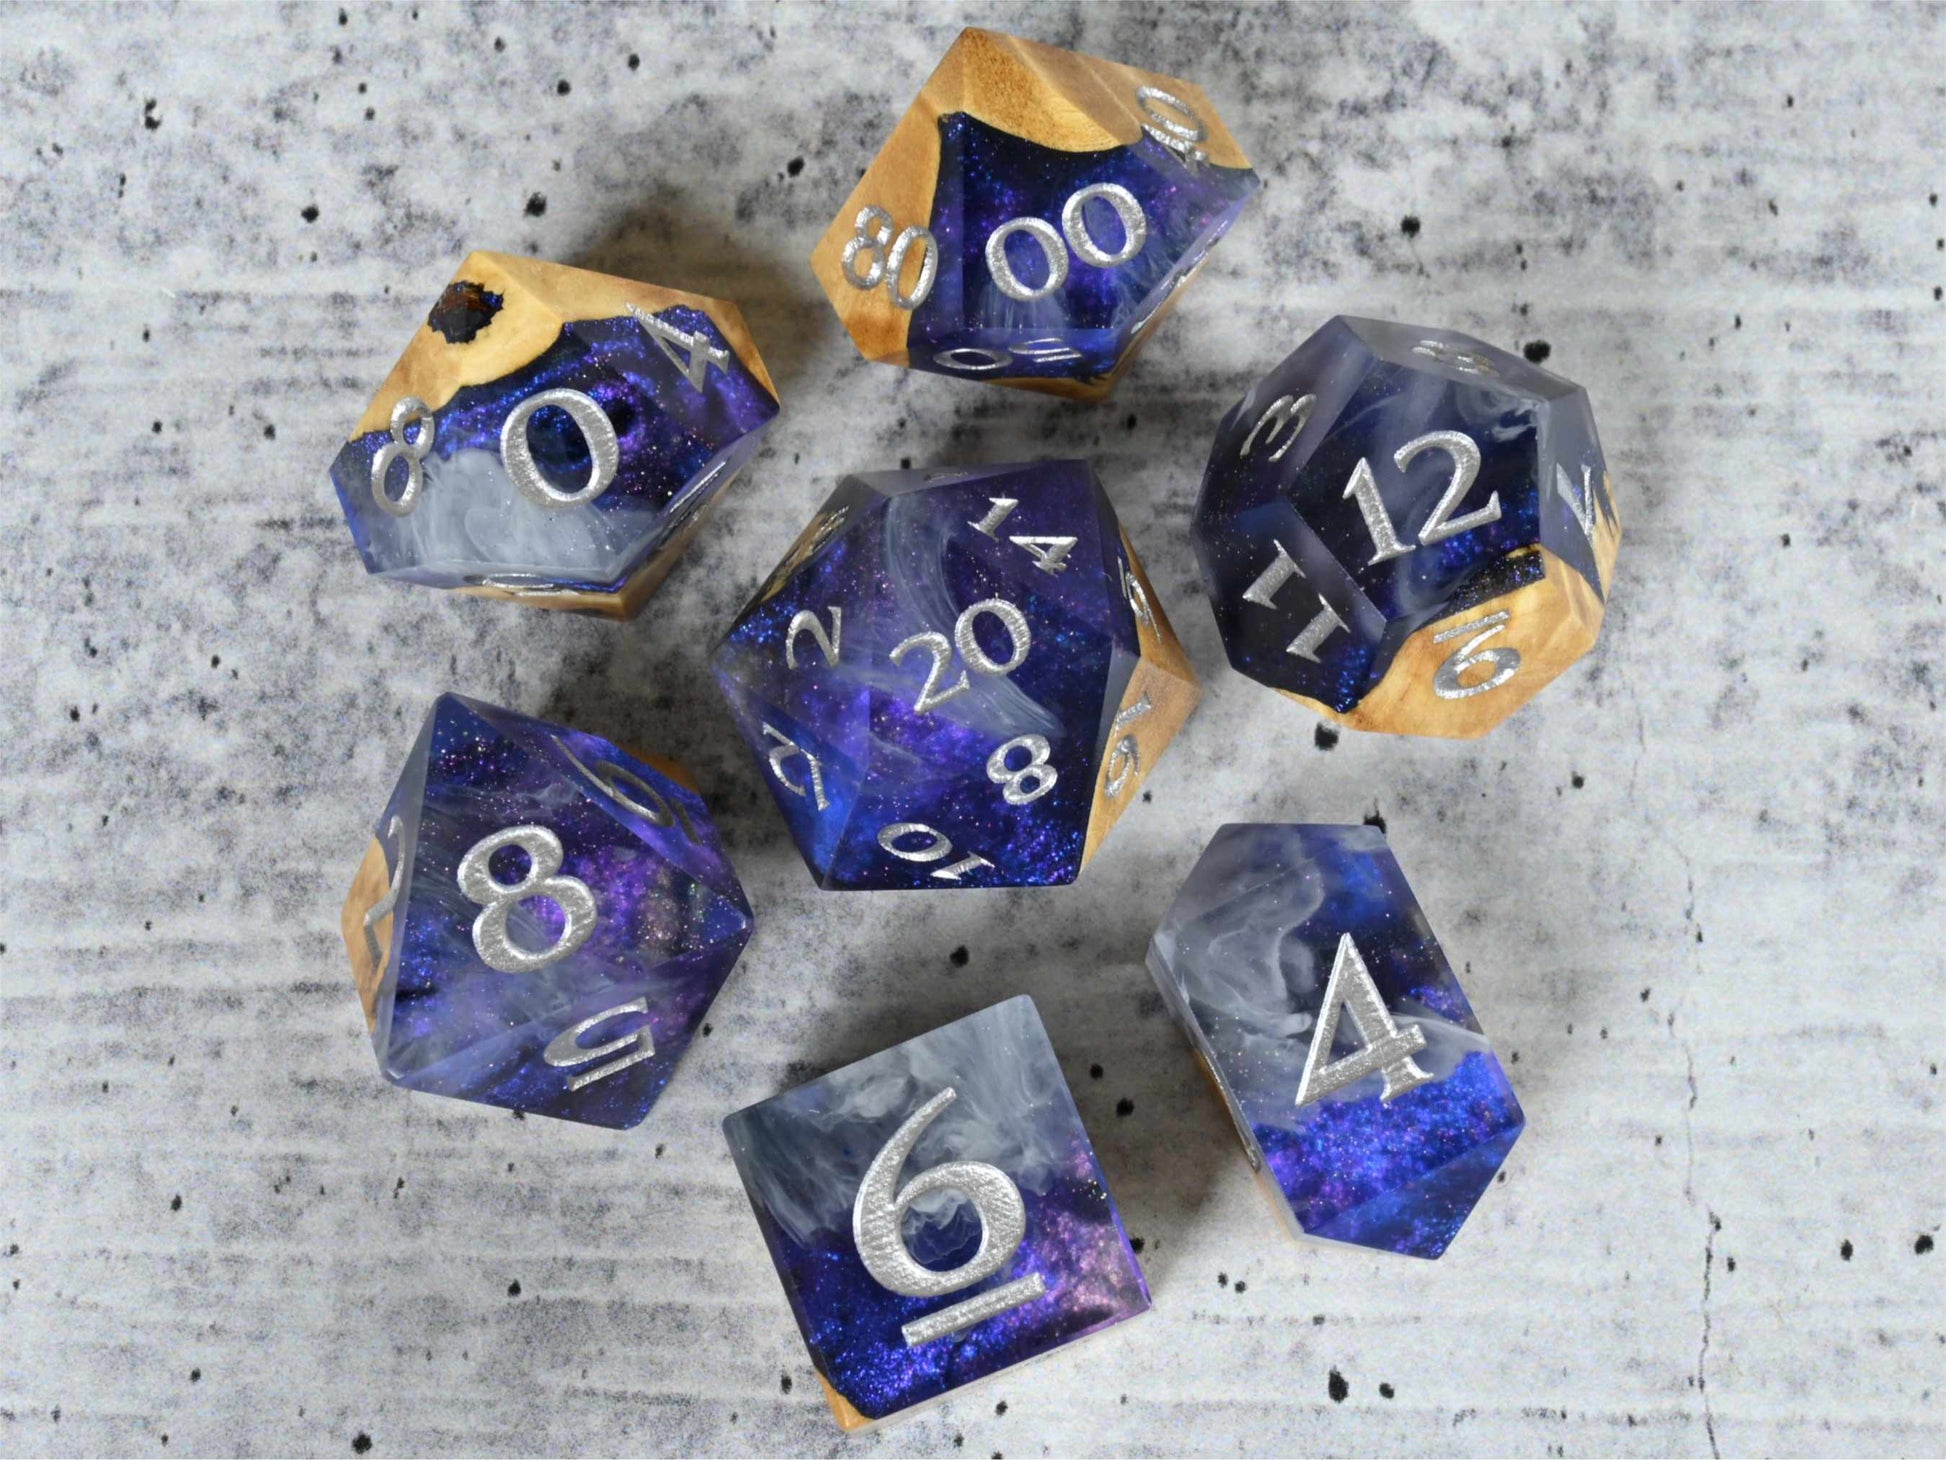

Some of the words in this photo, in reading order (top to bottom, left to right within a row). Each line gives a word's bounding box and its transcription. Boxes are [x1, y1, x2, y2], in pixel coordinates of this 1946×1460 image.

[841, 205, 938, 310] 80
[984, 182, 1147, 302] 00
[625, 301, 732, 394] 4
[370, 395, 435, 518] 8
[500, 387, 619, 509] 0
[1239, 393, 1317, 462] 3
[967, 494, 1078, 576] 14
[1342, 429, 1503, 565] 12
[1556, 462, 1593, 542] 7
[785, 606, 842, 671] 2
[889, 597, 1032, 715] 20
[1242, 538, 1352, 664] 11
[986, 733, 1058, 805] 8
[363, 814, 406, 976] 2
[456, 824, 597, 973] 8
[876, 822, 996, 882] 10
[543, 996, 656, 1092] 5
[1294, 931, 1435, 1107] 4
[852, 1086, 1047, 1348] 6
